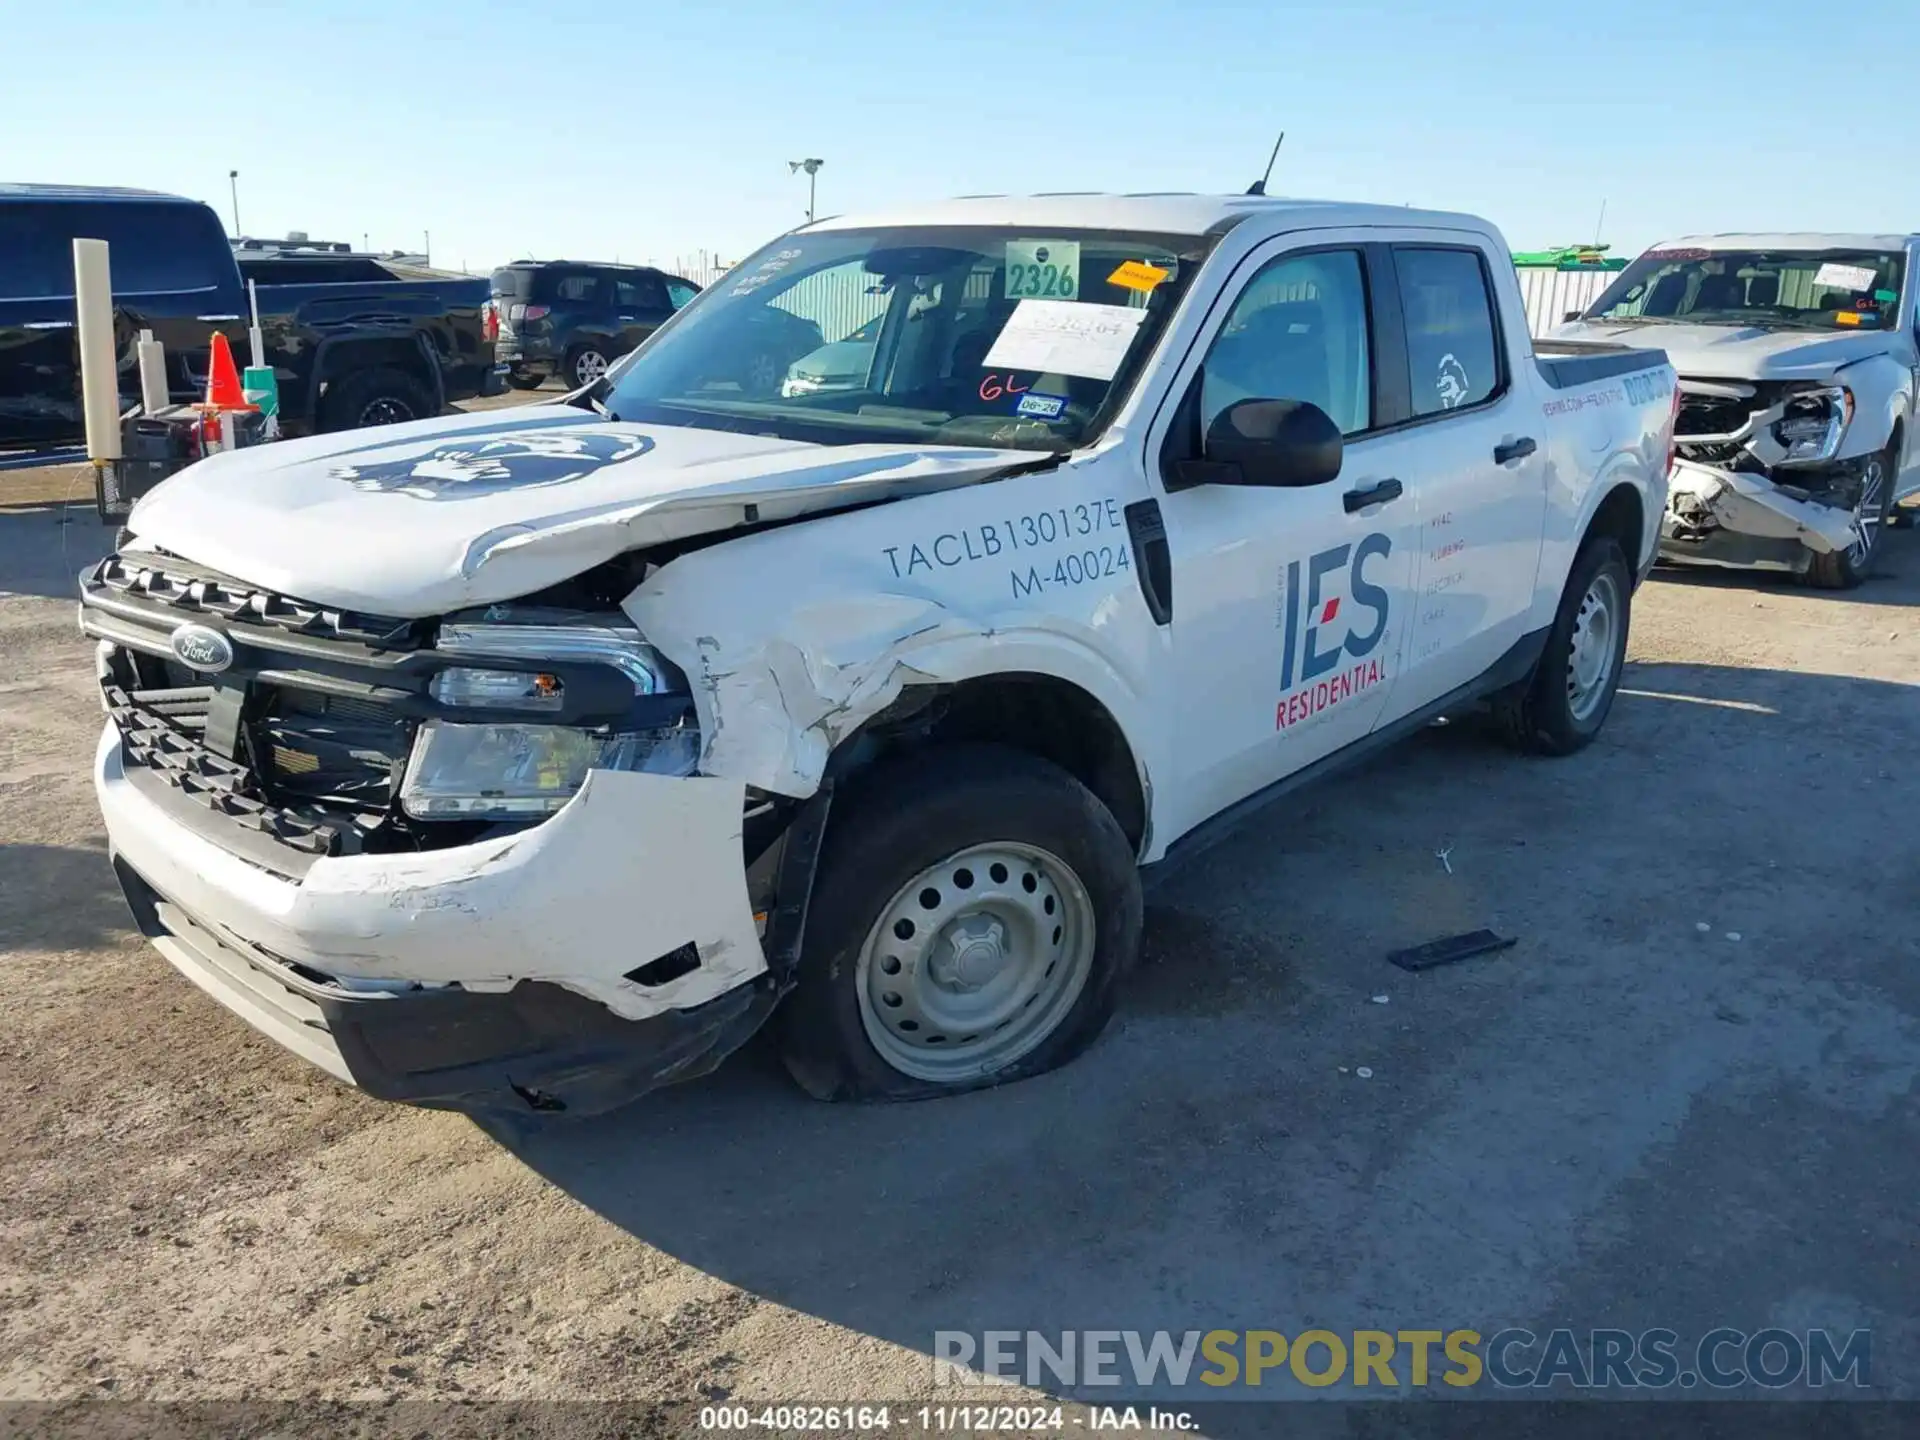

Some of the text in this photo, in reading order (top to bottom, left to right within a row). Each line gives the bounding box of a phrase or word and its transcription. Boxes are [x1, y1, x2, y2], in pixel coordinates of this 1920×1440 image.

[1009, 264, 1074, 296] 2326
[882, 498, 1121, 578] TACLB130137E
[1010, 544, 1130, 599] M-40024
[1279, 533, 1393, 692] IES
[181, 635, 216, 662] Ford
[1276, 656, 1386, 731] RESIDENTIAL
